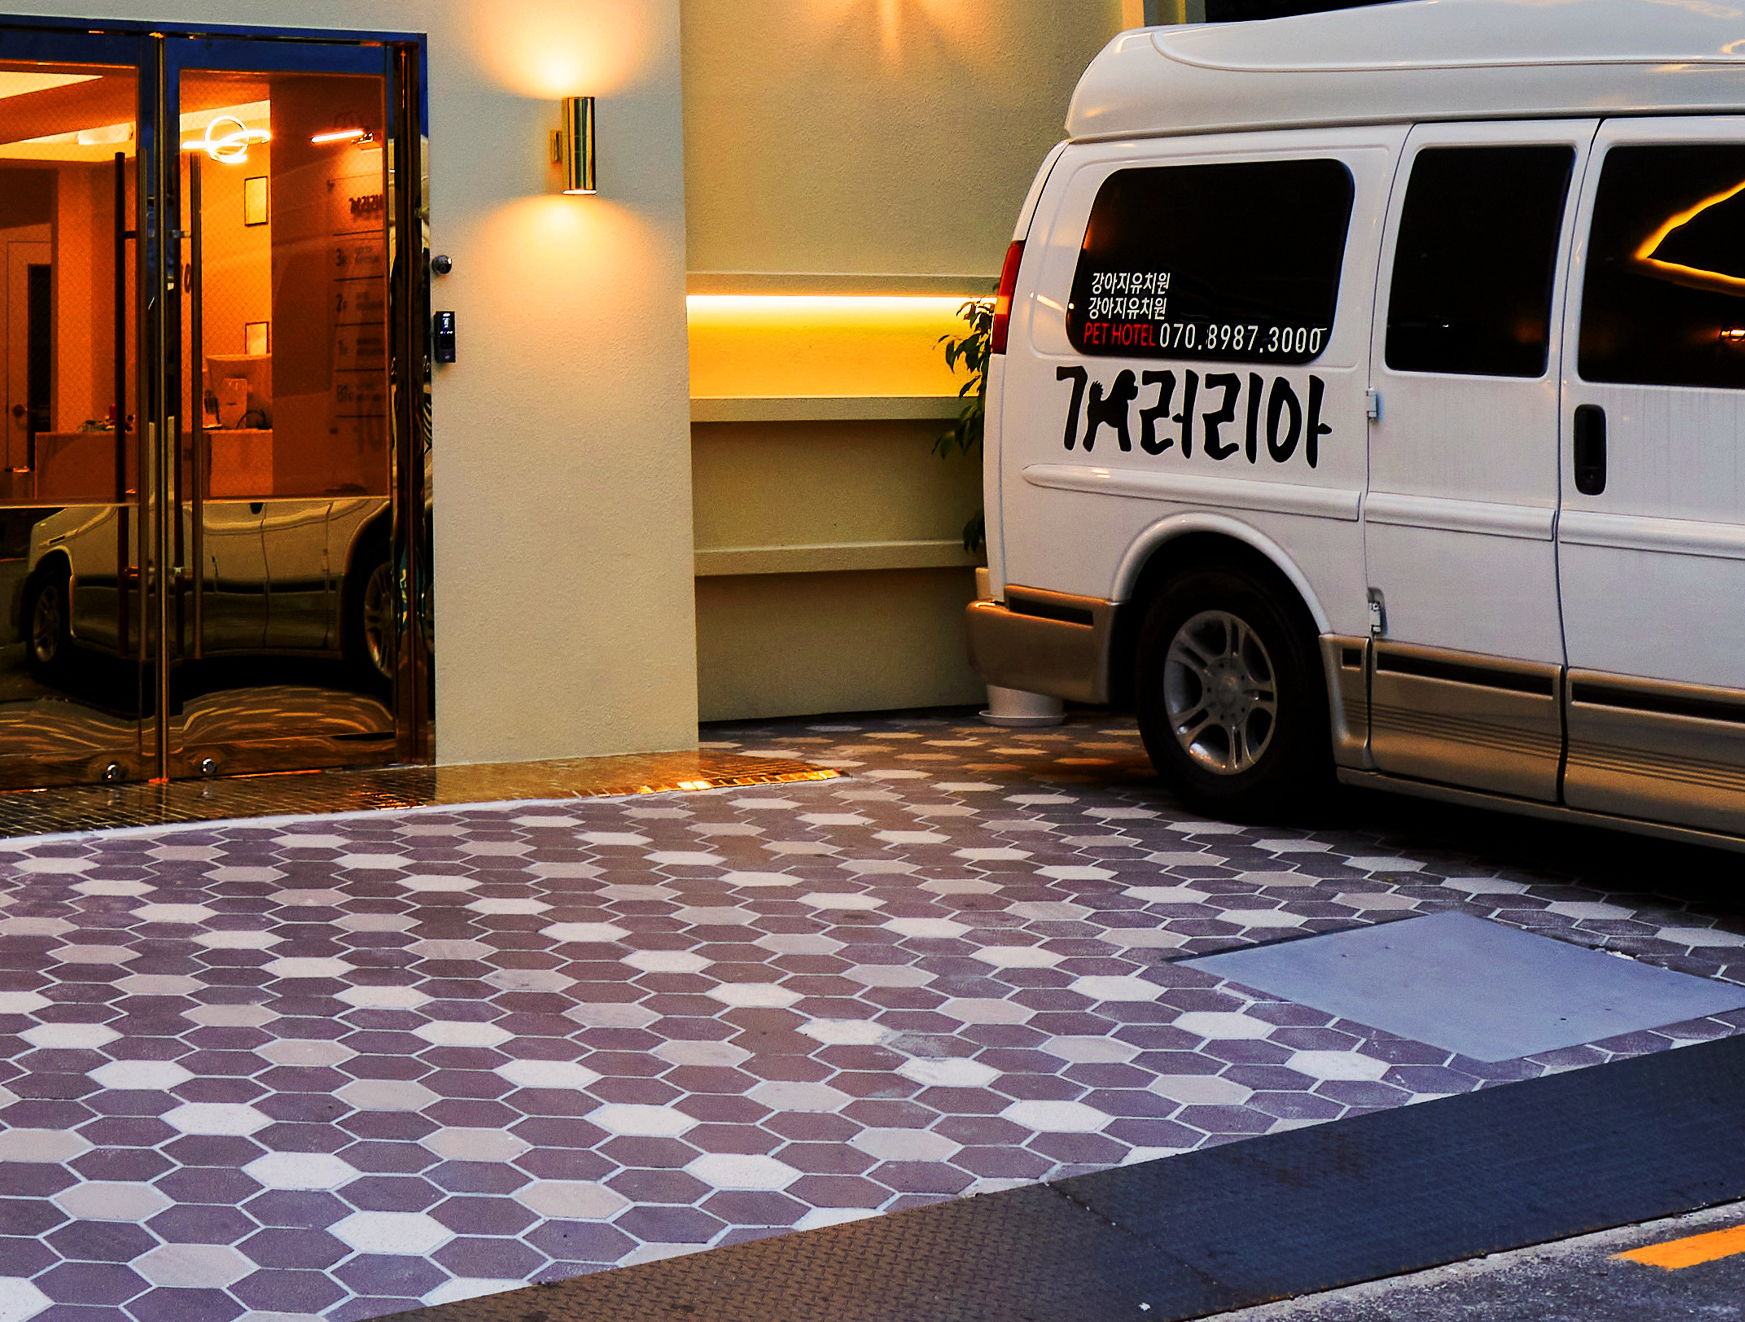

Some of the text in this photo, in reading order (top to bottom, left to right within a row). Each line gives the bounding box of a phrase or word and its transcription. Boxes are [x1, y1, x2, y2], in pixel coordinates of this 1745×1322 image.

[1091, 272, 1171, 295] 강아지유치원
[1088, 297, 1167, 320] 강아지유치원
[1083, 322, 1321, 354] PET HOTEL 070.8987.3000
